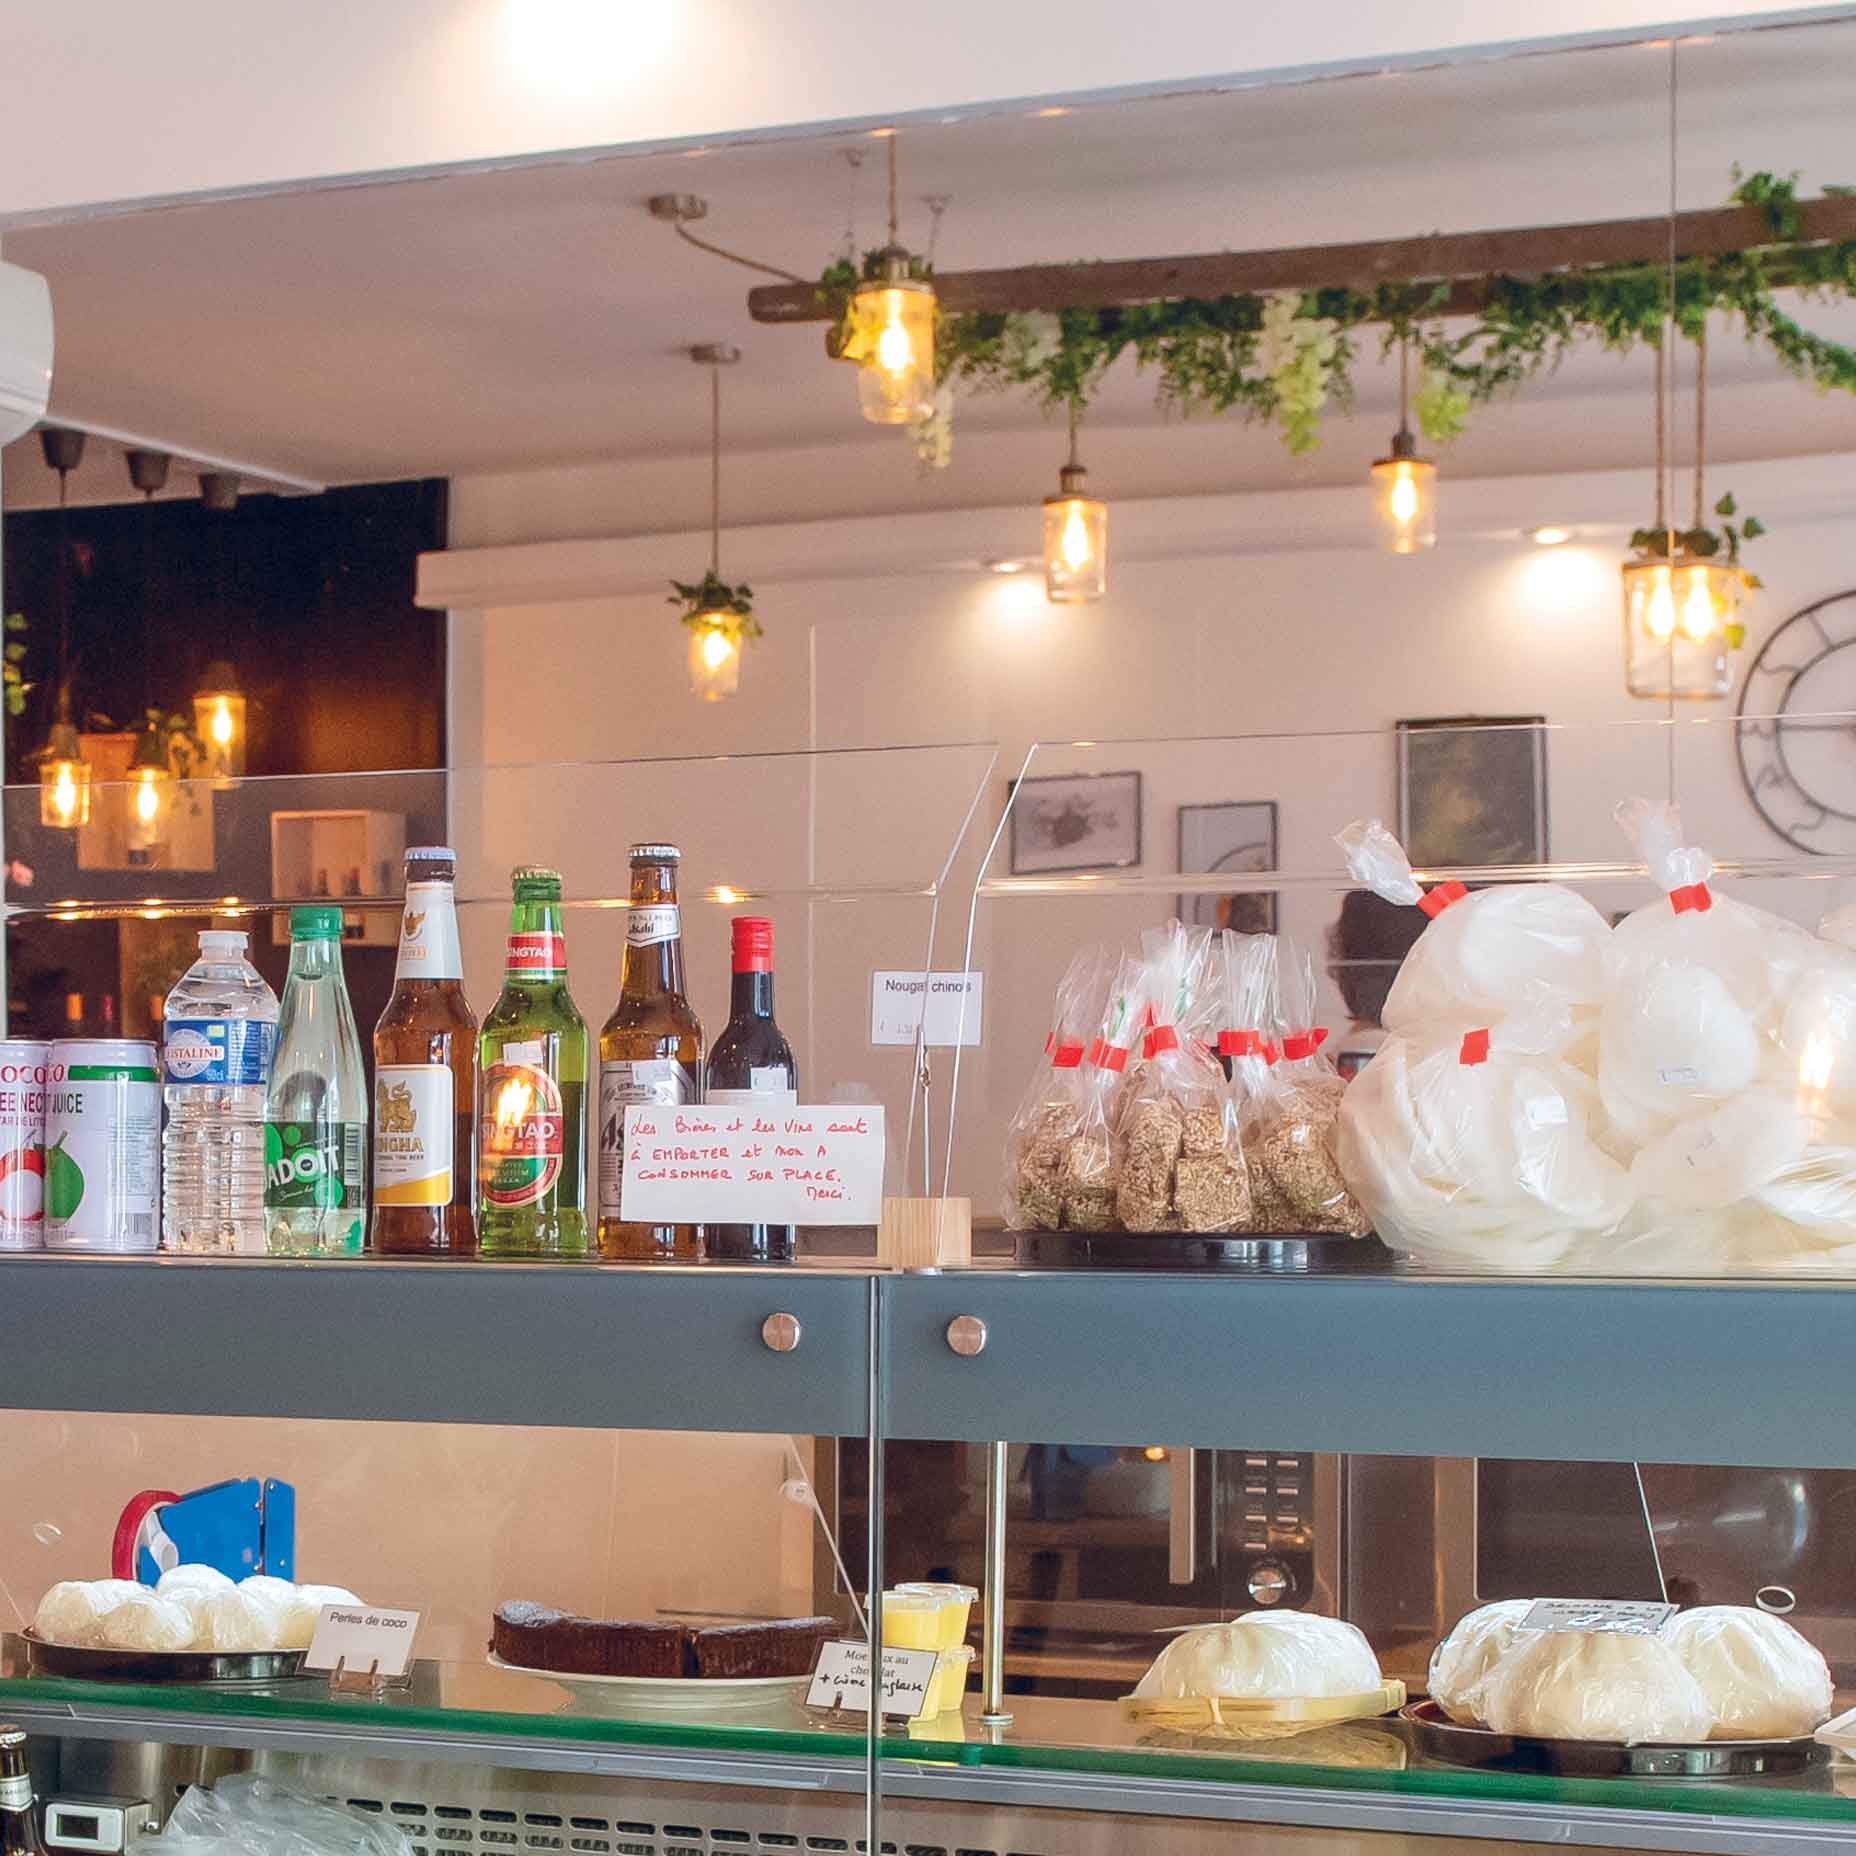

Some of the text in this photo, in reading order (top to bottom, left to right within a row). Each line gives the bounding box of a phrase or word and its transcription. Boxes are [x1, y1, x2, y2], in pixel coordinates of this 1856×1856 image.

[931, 980, 972, 993] chinos
[52, 1093, 83, 1113] JUICE
[631, 1113, 657, 1136] Les
[726, 1117, 744, 1133] et
[751, 1117, 776, 1134] les
[652, 1148, 730, 1162] EMPORTER
[263, 1145, 340, 1192] ADOIT
[637, 1167, 733, 1181] CONSOMMER
[746, 1168, 774, 1182] SUR
[330, 1611, 408, 1629] Perles de coco
